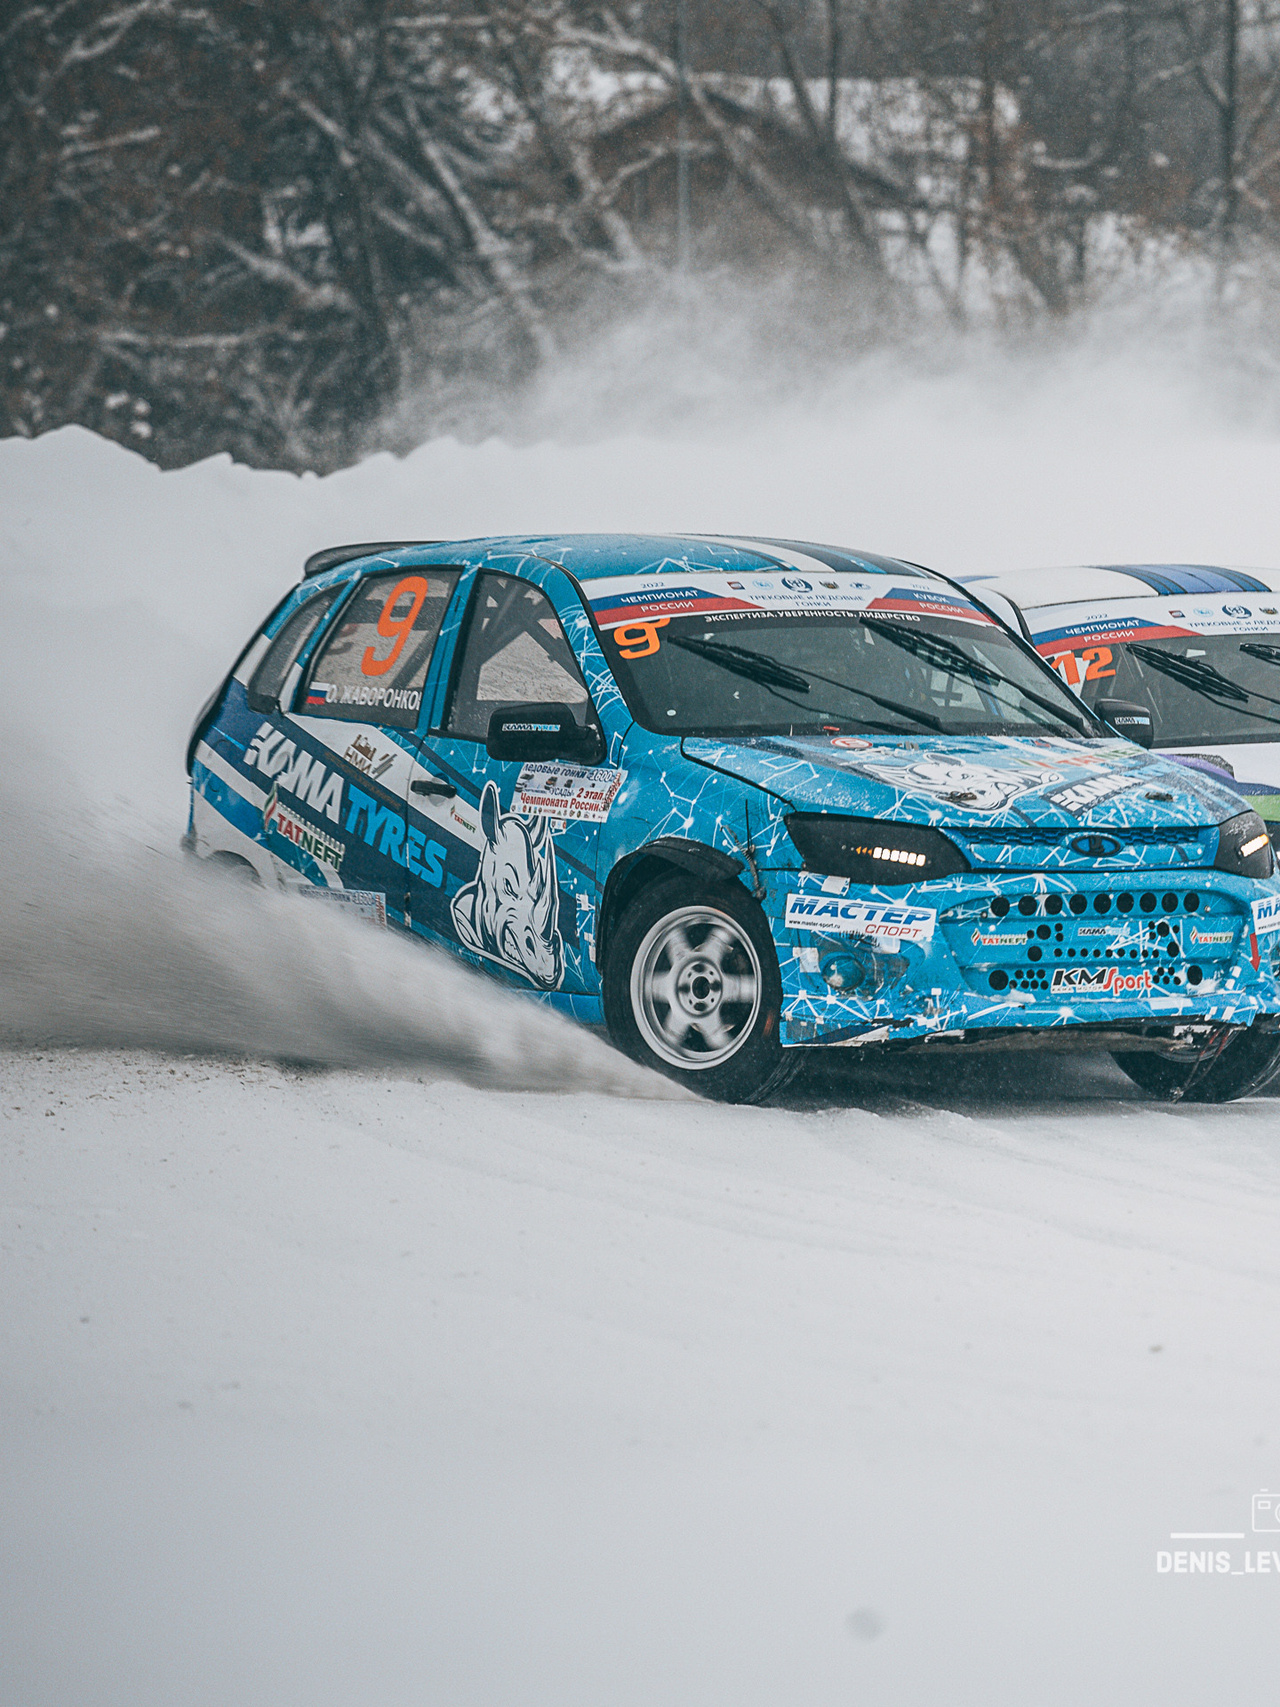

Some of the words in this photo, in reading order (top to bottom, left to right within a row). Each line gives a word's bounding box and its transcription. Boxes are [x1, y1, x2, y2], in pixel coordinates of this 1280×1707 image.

[621, 590, 698, 604] ЧЕМПИОНАТ
[913, 592, 950, 603] КУБОК
[641, 601, 694, 612] РОССИИ
[919, 602, 964, 614] РОССИИ
[859, 611, 921, 622] ЛИДЕРСТВО
[1085, 613, 1108, 621] 2022
[361, 576, 428, 676] 9
[1065, 619, 1140, 636] ЧЕМПИОНАТ
[613, 618, 671, 660] 9
[1084, 630, 1135, 643] РОССИИ
[1050, 647, 1116, 686] 12
[576, 787, 585, 798] 2
[520, 792, 569, 808] Чемпионата
[569, 798, 600, 812] России
[276, 812, 344, 872] TATNEFT
[345, 783, 448, 888] TYRES
[789, 896, 932, 925] МАСТЕР
[865, 923, 922, 939] СПОРТ
[980, 936, 1029, 946] TATNEFT
[1198, 935, 1233, 944] TATNEFT
